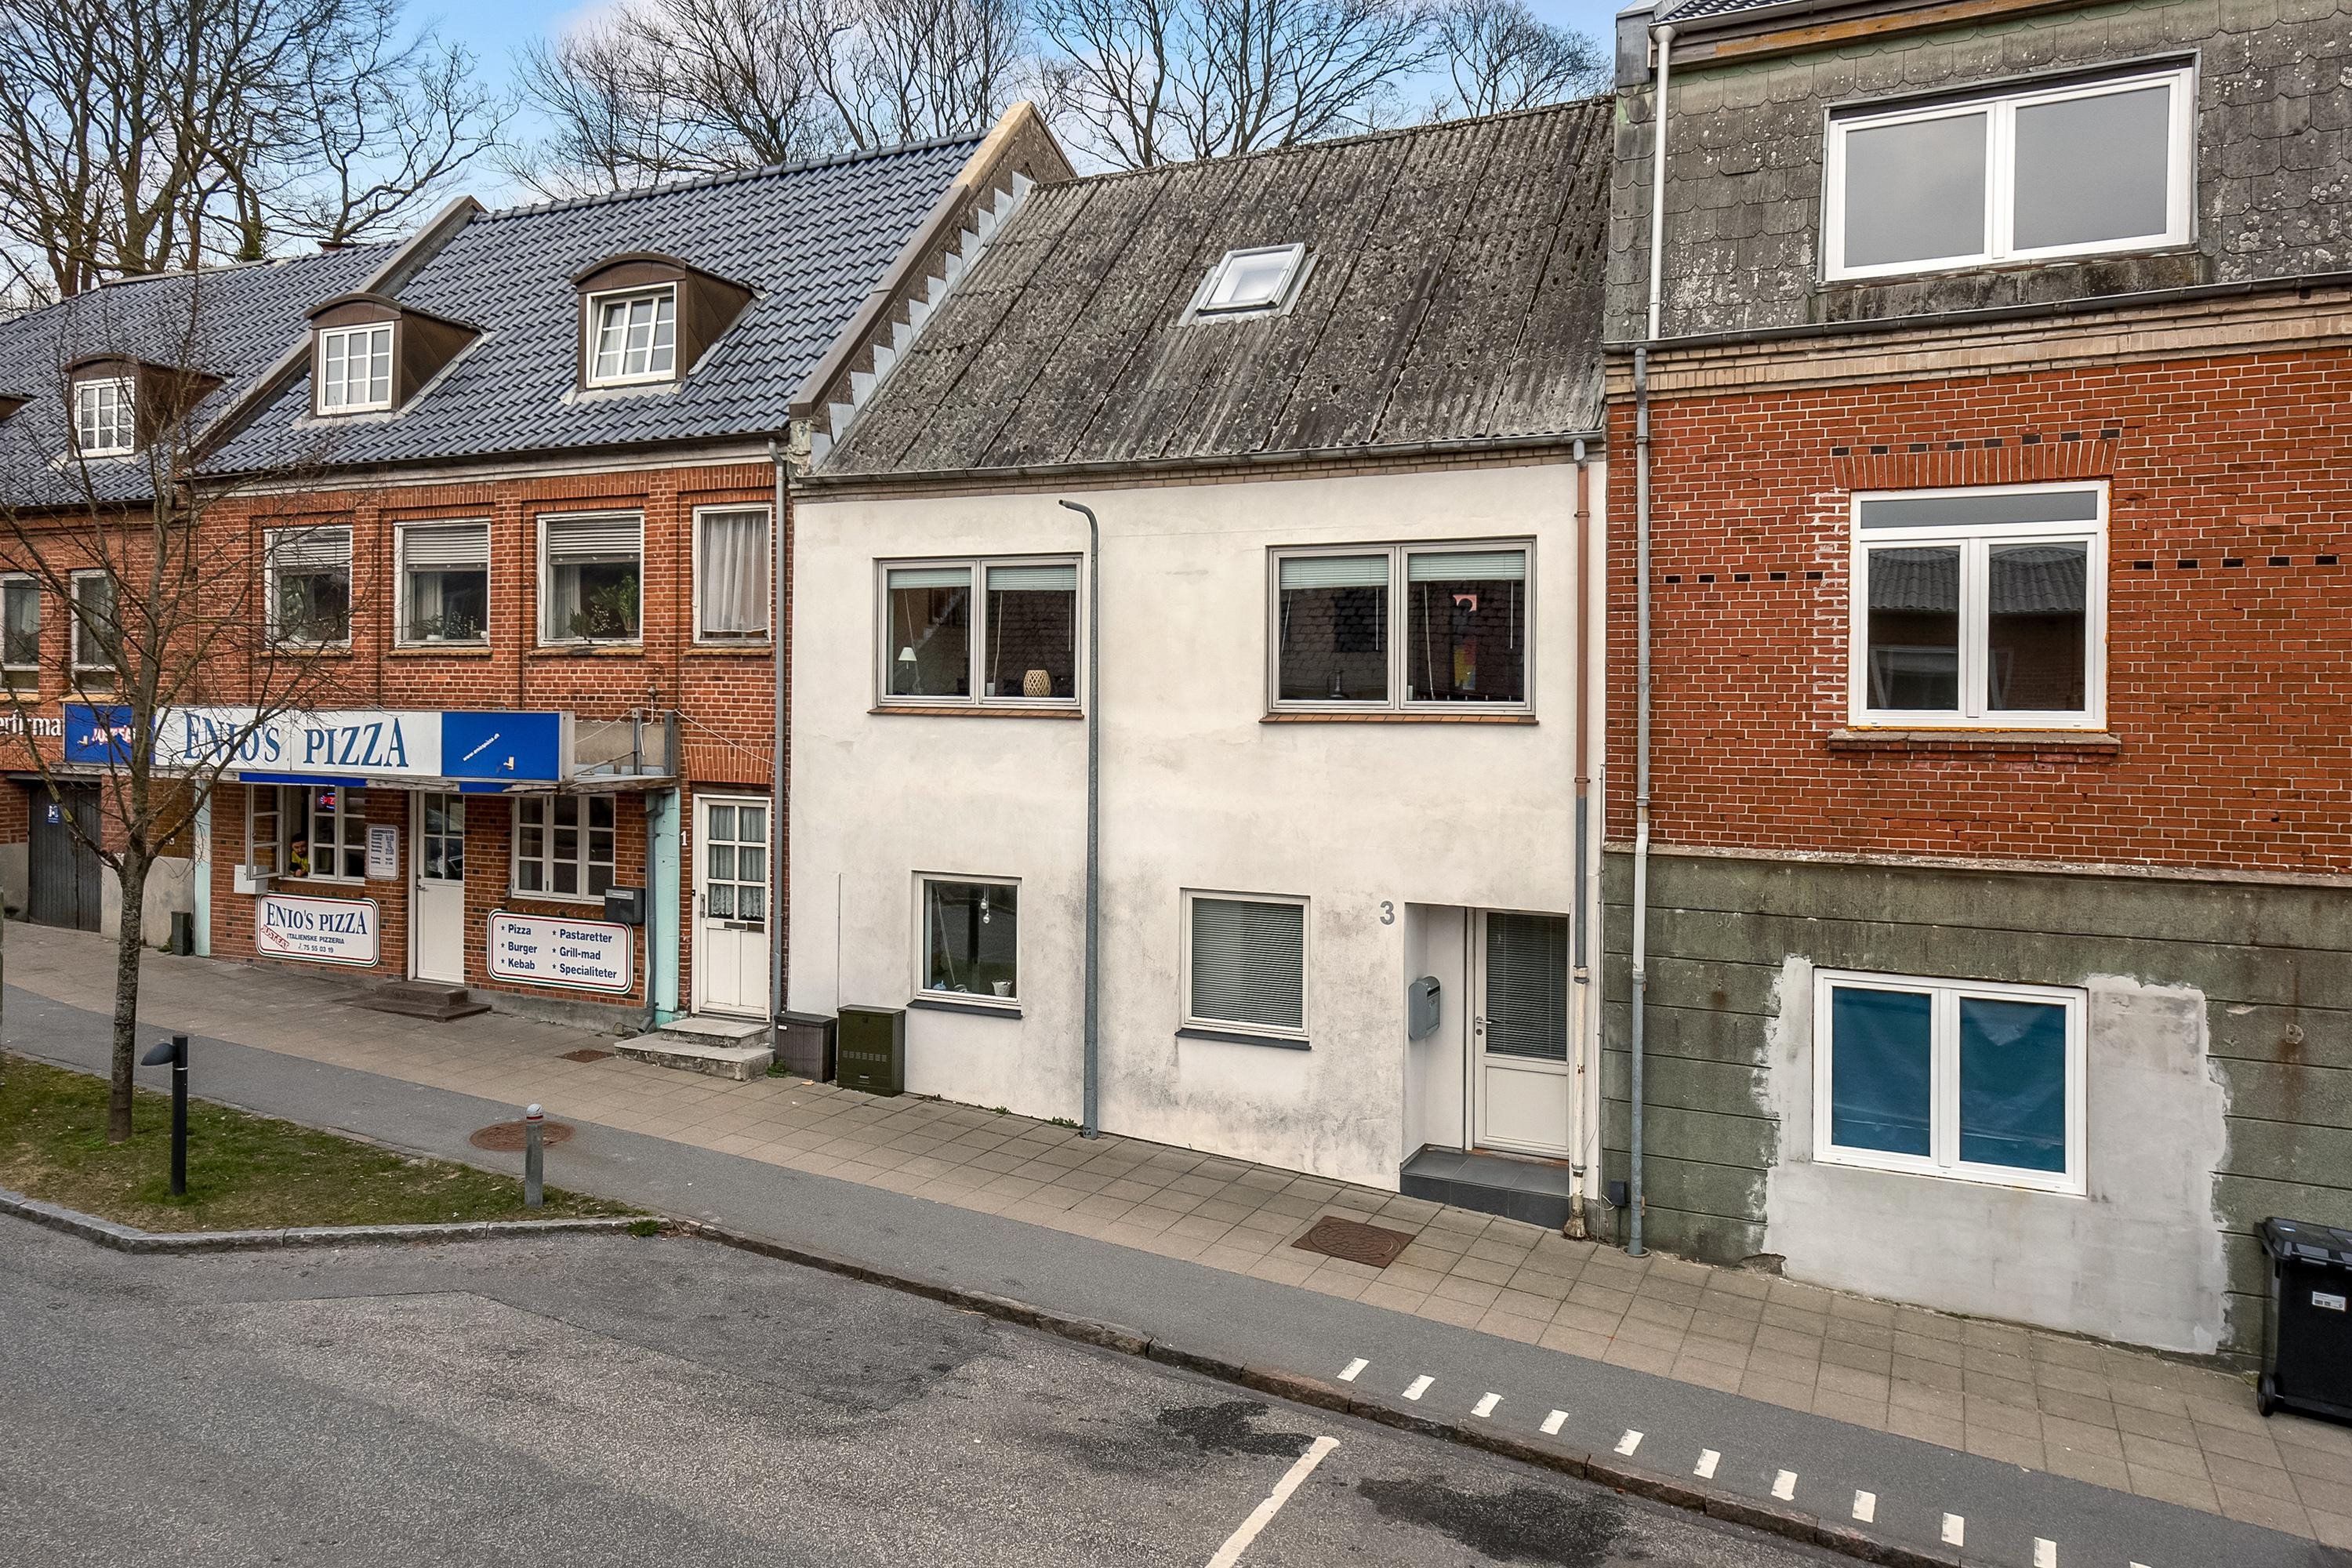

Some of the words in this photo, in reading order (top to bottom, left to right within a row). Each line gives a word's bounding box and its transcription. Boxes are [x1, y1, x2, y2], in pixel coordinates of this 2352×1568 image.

[183, 711, 280, 763] ENIO'S
[303, 717, 409, 768] PIZZA
[681, 830, 688, 846] 1
[267, 902, 314, 931] ENIO'S
[319, 910, 368, 935] PIZZA
[1380, 901, 1395, 925] 3
[508, 924, 532, 935] Pizza
[560, 928, 613, 943] Pastaretter
[287, 933, 318, 942] ITALIENSKE
[320, 936, 345, 945] PIZZERIA
[508, 941, 538, 955] Burger
[560, 946, 601, 960] Grill-mad
[508, 957, 535, 970] Kebab
[560, 963, 618, 978] Specialiteter
